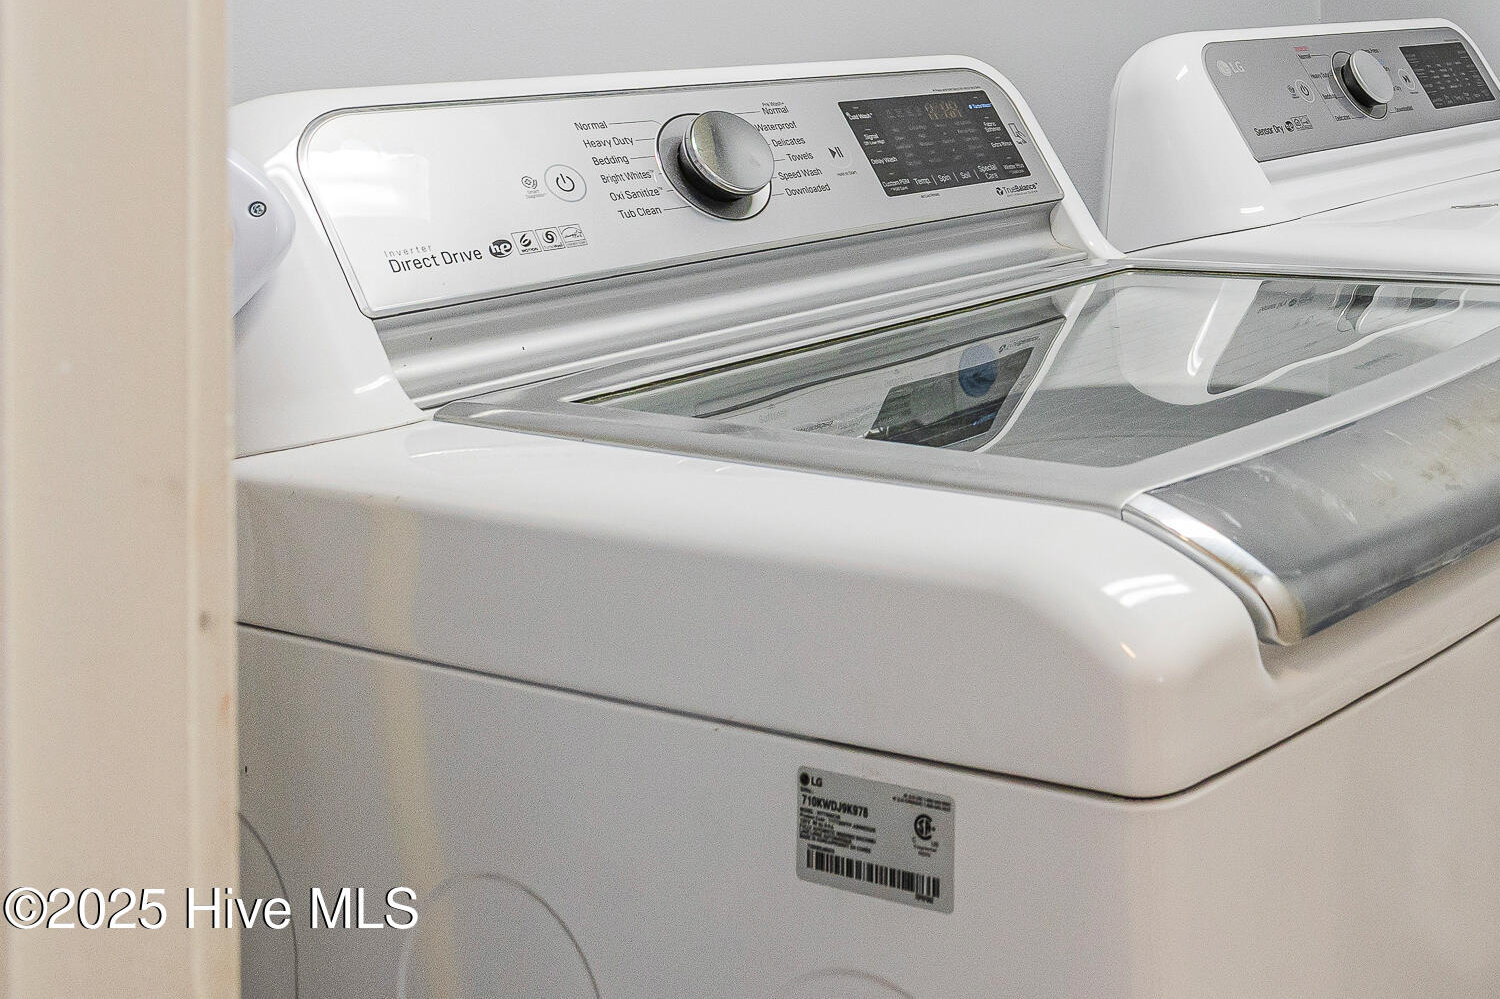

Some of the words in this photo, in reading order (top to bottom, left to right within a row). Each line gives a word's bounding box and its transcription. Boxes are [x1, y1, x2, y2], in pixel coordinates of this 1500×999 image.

[1229, 61, 1245, 74] LG
[761, 105, 789, 116] Normal
[573, 120, 608, 131] Normal
[754, 120, 798, 132] Waterproof
[1254, 125, 1274, 137] Sensor
[1273, 124, 1285, 134] Dry
[582, 139, 612, 149] Heavy
[611, 136, 634, 146] Duty
[771, 137, 806, 148] Delicates
[591, 155, 630, 166] Bedding
[786, 151, 815, 162] Towels
[777, 171, 802, 181] Speed
[801, 167, 823, 178] Wash
[977, 163, 998, 173] Special
[600, 172, 626, 185] Bright
[937, 173, 952, 183] Spin
[960, 171, 971, 179] Soil
[984, 172, 999, 180] Care
[784, 182, 832, 197] Downloaded
[609, 192, 625, 202] Oxi
[617, 208, 637, 220] Tub
[636, 206, 662, 218] Clean
[384, 244, 432, 258] Inverter
[388, 254, 440, 274] Direct
[440, 249, 483, 265] Drive
[811, 776, 823, 788] LG
